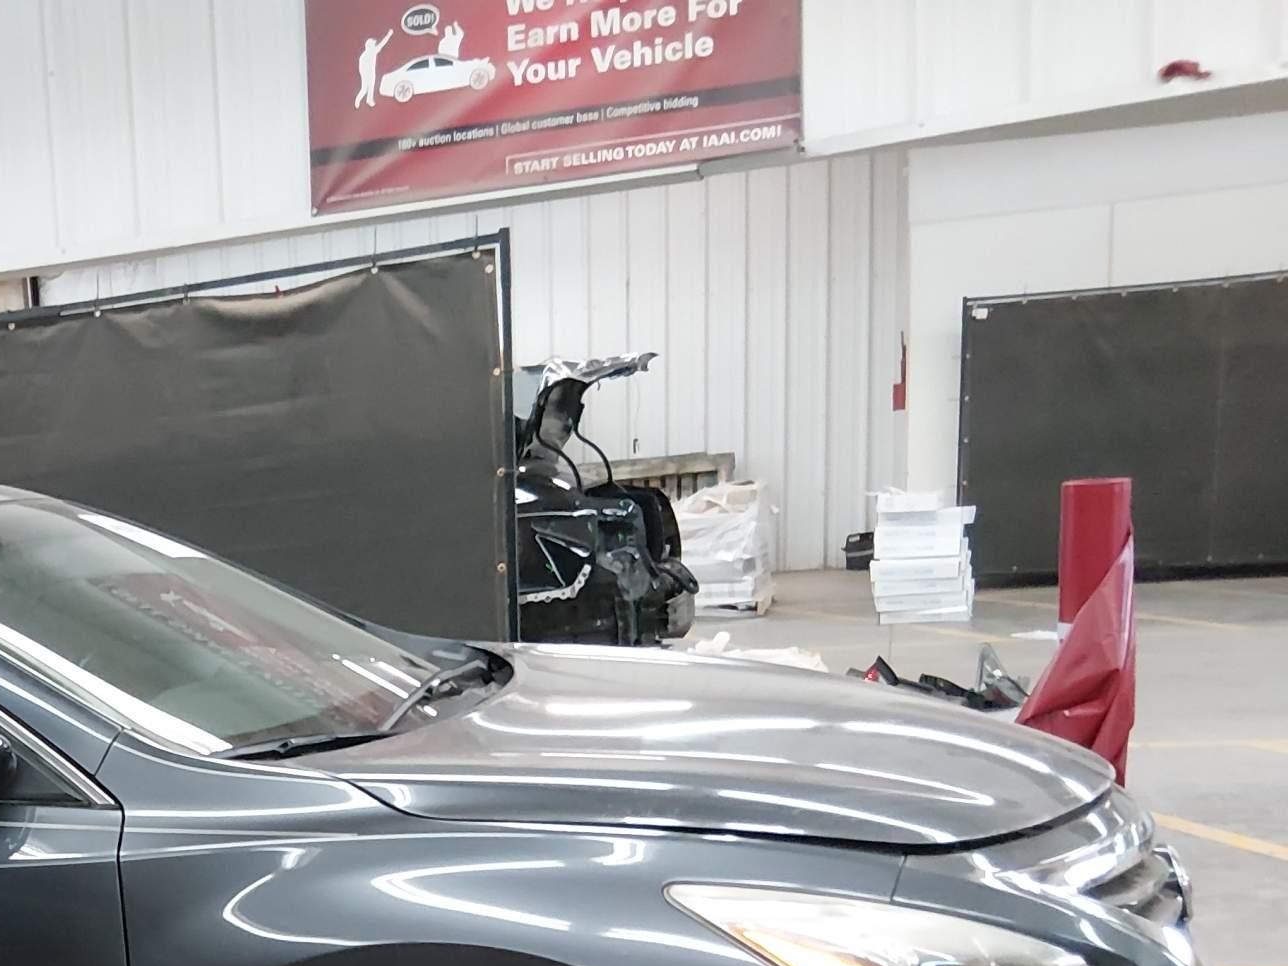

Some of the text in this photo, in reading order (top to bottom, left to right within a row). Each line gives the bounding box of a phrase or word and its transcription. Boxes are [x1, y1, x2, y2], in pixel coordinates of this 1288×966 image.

[507, 0, 742, 51] Earn More For
[508, 32, 714, 86] Your Vehicle
[419, 135, 451, 148] auction
[453, 126, 493, 142] locations
[501, 120, 530, 135] Global
[532, 114, 574, 129] customer
[606, 101, 661, 119] Competitive
[664, 96, 699, 111] bidding
[514, 124, 782, 175] START SELLING TODAY AT IAAI.COM!
